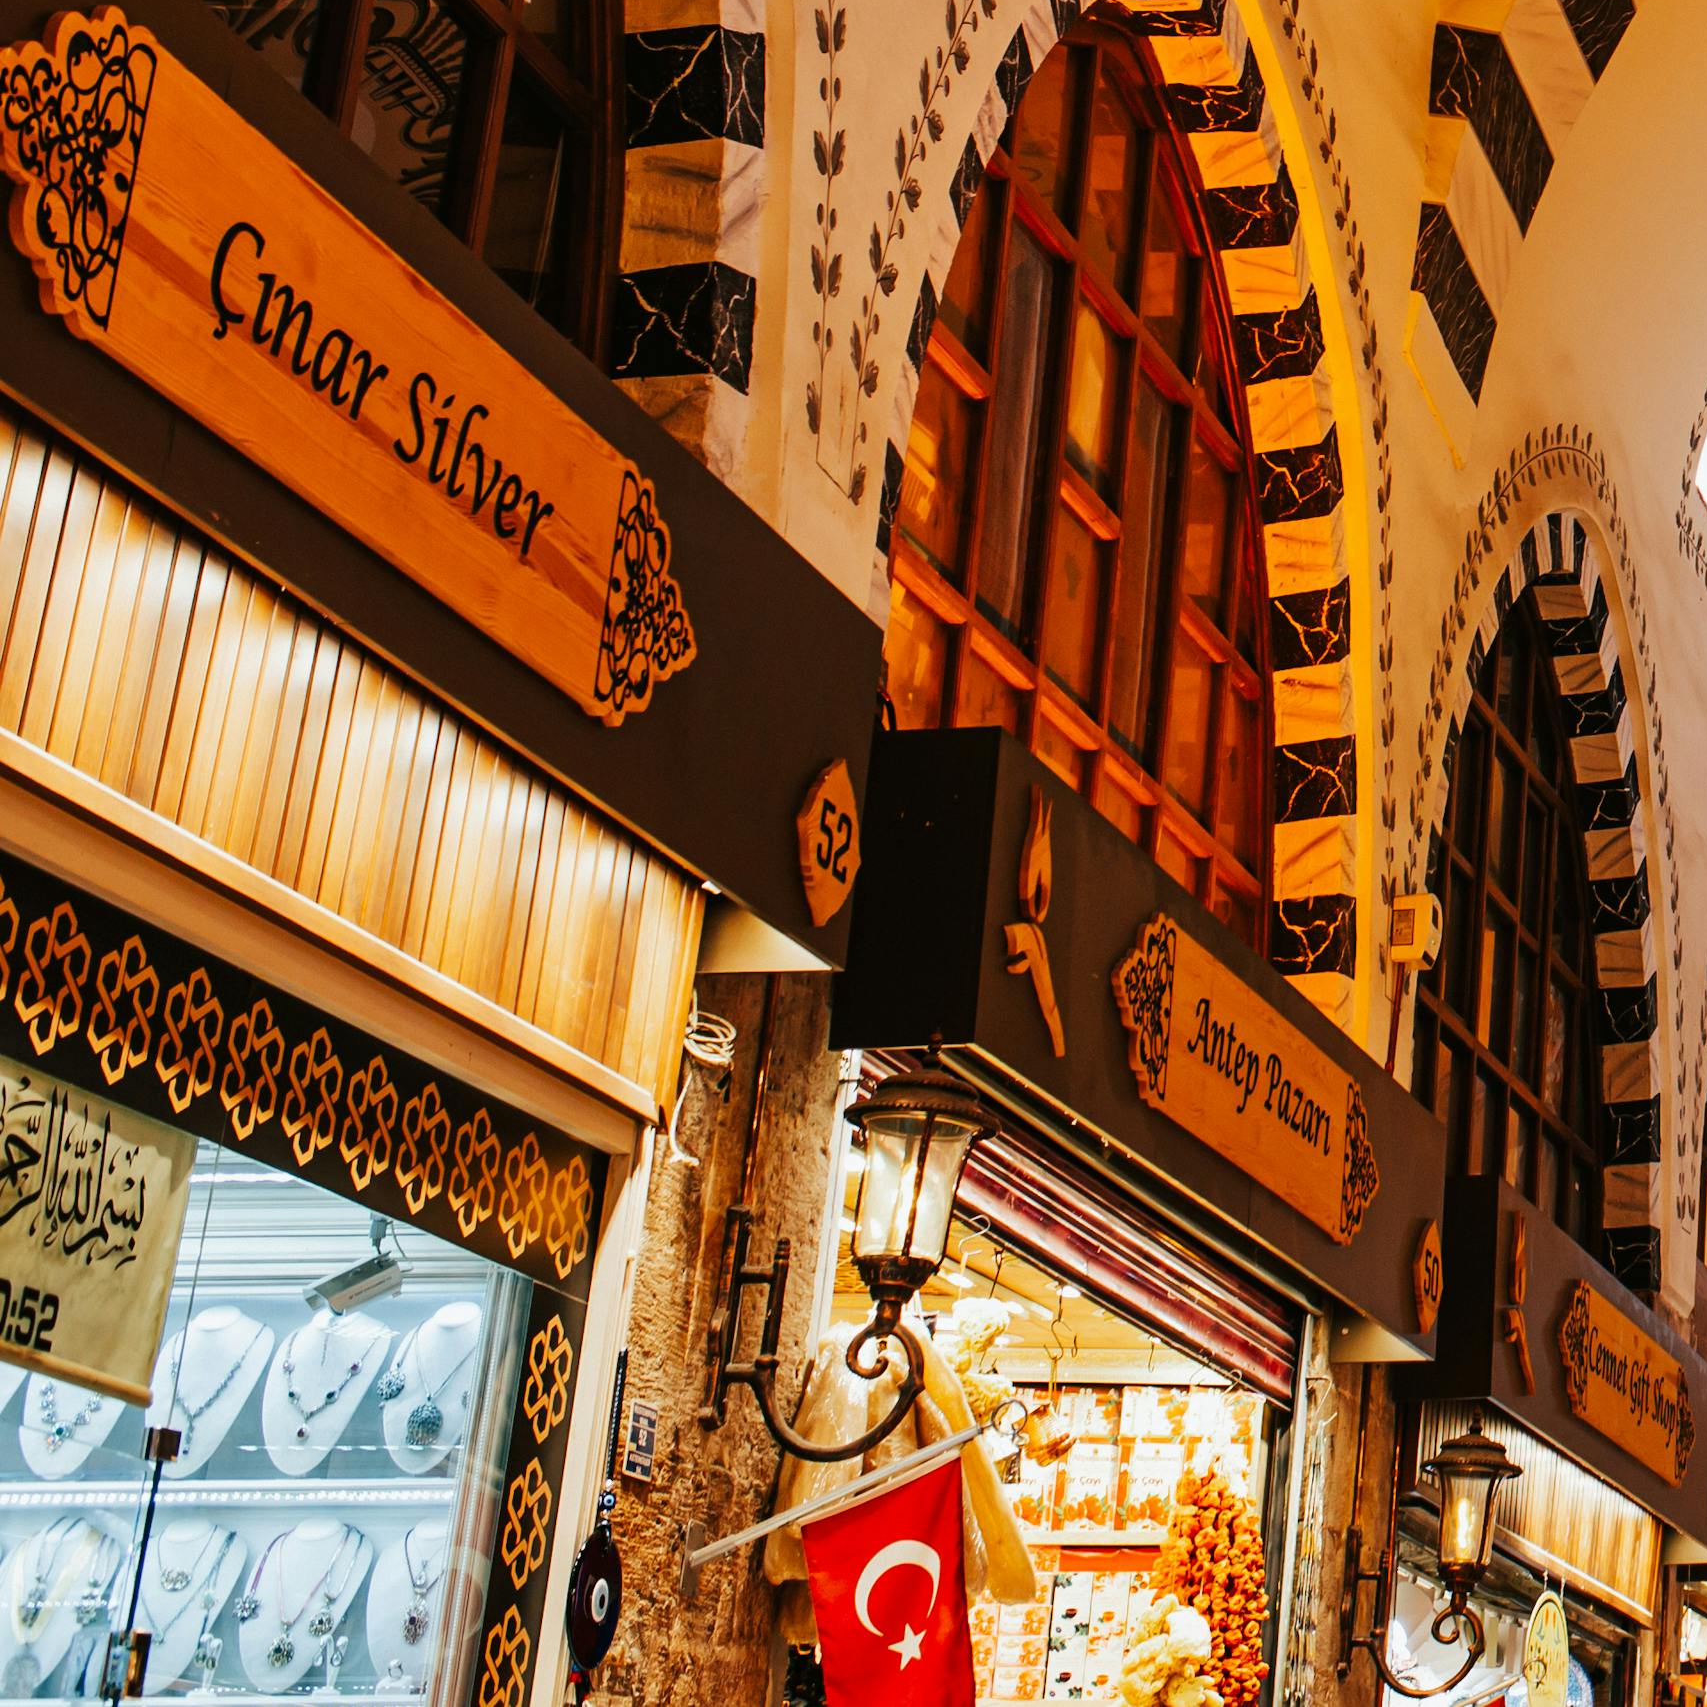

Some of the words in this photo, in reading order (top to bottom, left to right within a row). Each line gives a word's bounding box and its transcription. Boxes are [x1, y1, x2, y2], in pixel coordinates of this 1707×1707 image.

[210, 221, 388, 421] Çınar
[393, 372, 555, 557] Silver
[815, 798, 854, 884] 52
[1187, 997, 1260, 1114] Antep
[1264, 1053, 1331, 1156] Pazarı
[1424, 1246, 1440, 1303] 50
[1588, 1326, 1627, 1395] Cennet
[1629, 1360, 1649, 1426] Gift
[1651, 1376, 1676, 1448] Shop
